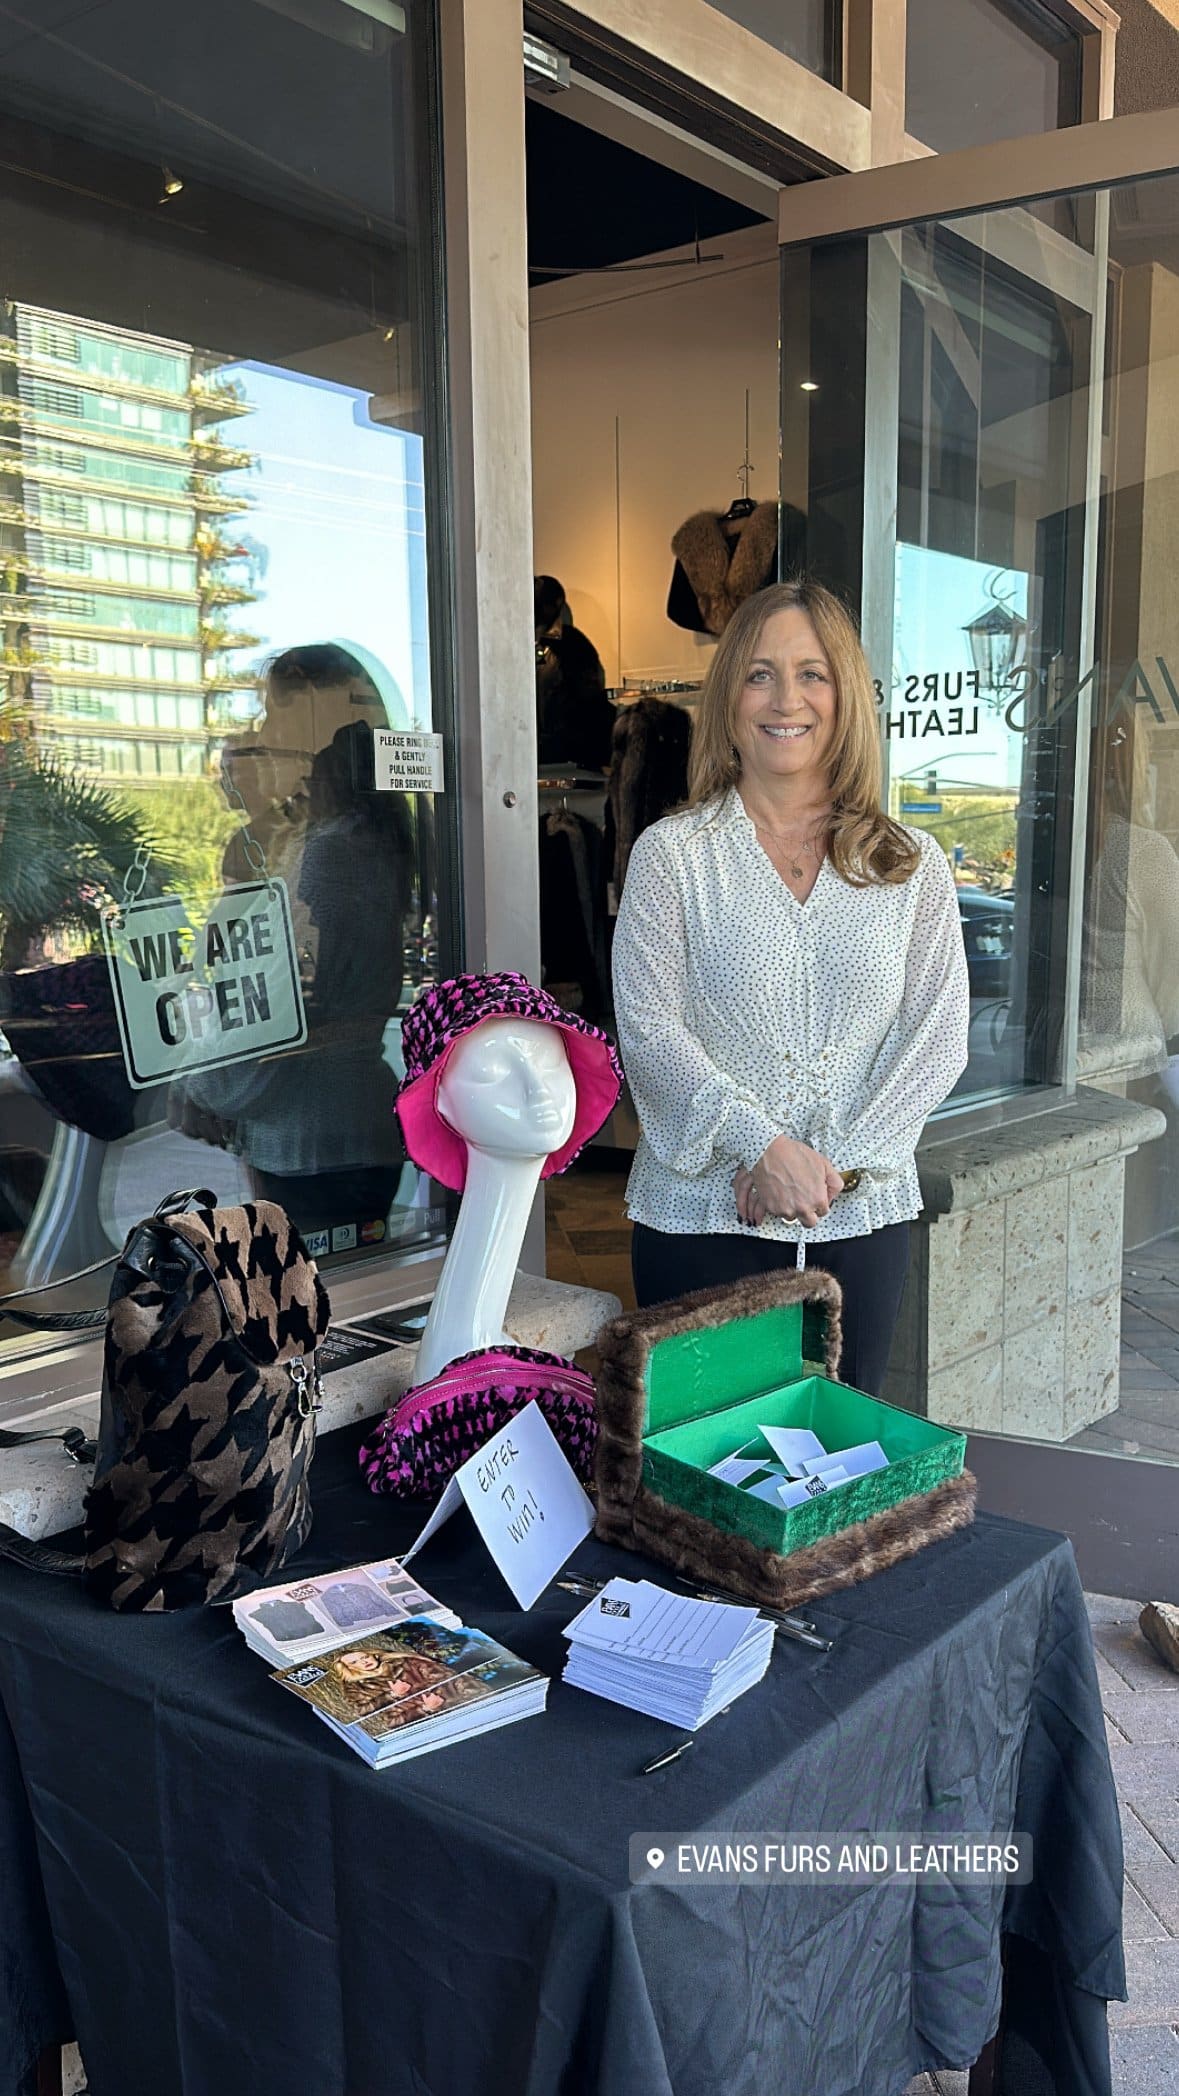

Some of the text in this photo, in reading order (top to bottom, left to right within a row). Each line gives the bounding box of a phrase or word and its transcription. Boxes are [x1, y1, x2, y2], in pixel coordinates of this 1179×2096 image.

[380, 736, 405, 747] PLEASE
[395, 751, 425, 761] & GENTLY
[389, 764, 432, 775] PULL HANDLE
[390, 778, 432, 789] FOR SERVICE
[129, 913, 274, 982] WE ARE
[156, 972, 272, 1046] OPEN
[476, 1439, 520, 1493] ENTER
[501, 1484, 515, 1511] TO
